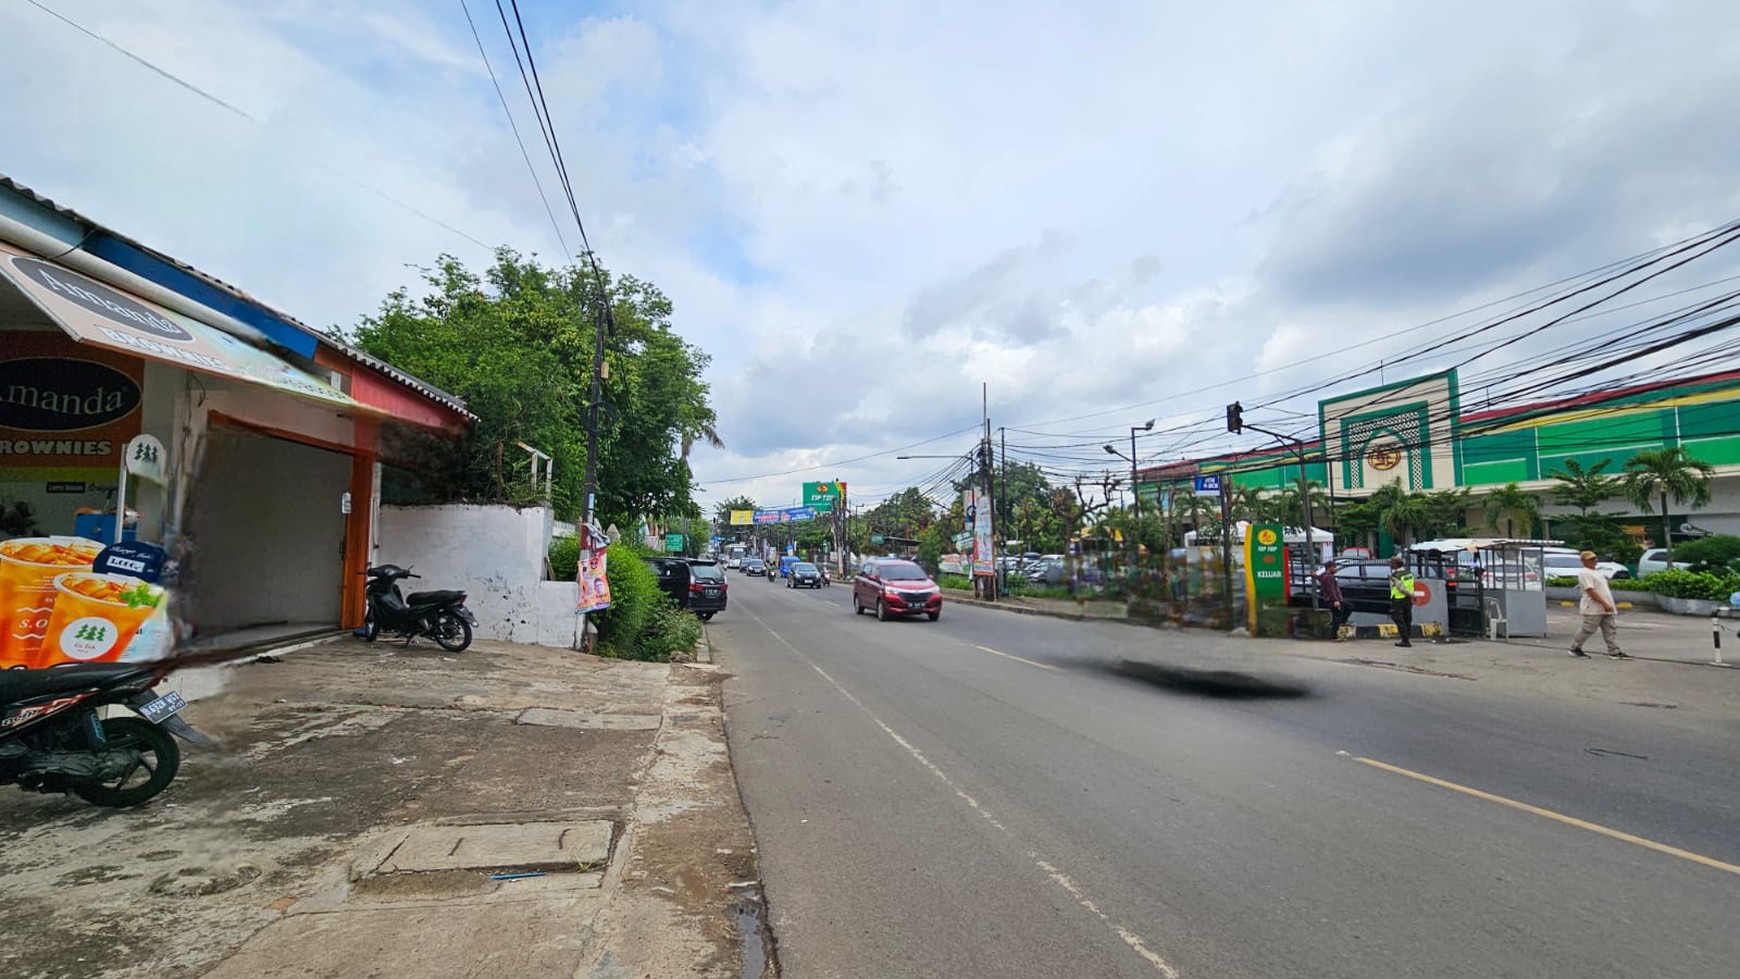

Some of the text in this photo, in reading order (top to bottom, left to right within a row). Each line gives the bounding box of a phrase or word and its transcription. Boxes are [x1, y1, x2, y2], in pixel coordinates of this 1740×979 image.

[37, 268, 184, 335] Amanda
[97, 325, 232, 370] BROWNIES
[0, 384, 122, 416] manda
